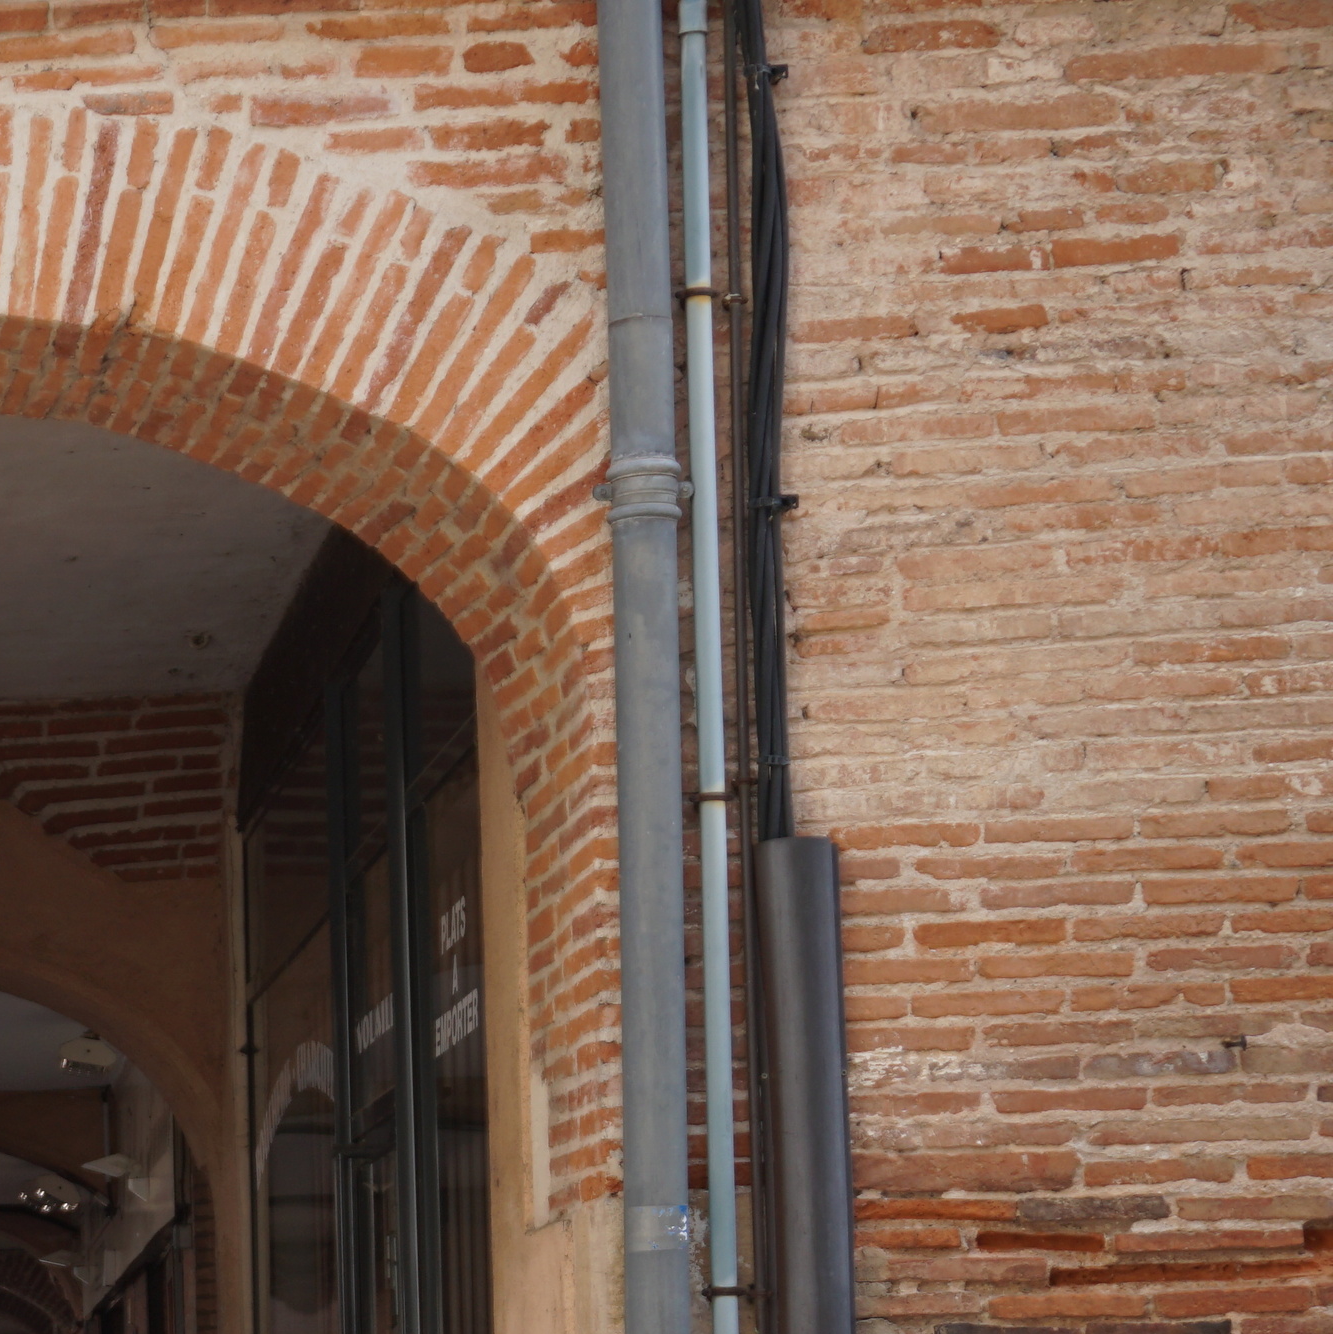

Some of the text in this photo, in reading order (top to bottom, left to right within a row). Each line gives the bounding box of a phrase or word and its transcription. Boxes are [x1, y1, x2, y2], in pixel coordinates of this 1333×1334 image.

[440, 895, 466, 955] PLATS
[452, 954, 459, 995] A
[435, 988, 479, 1058] EMPORTER
